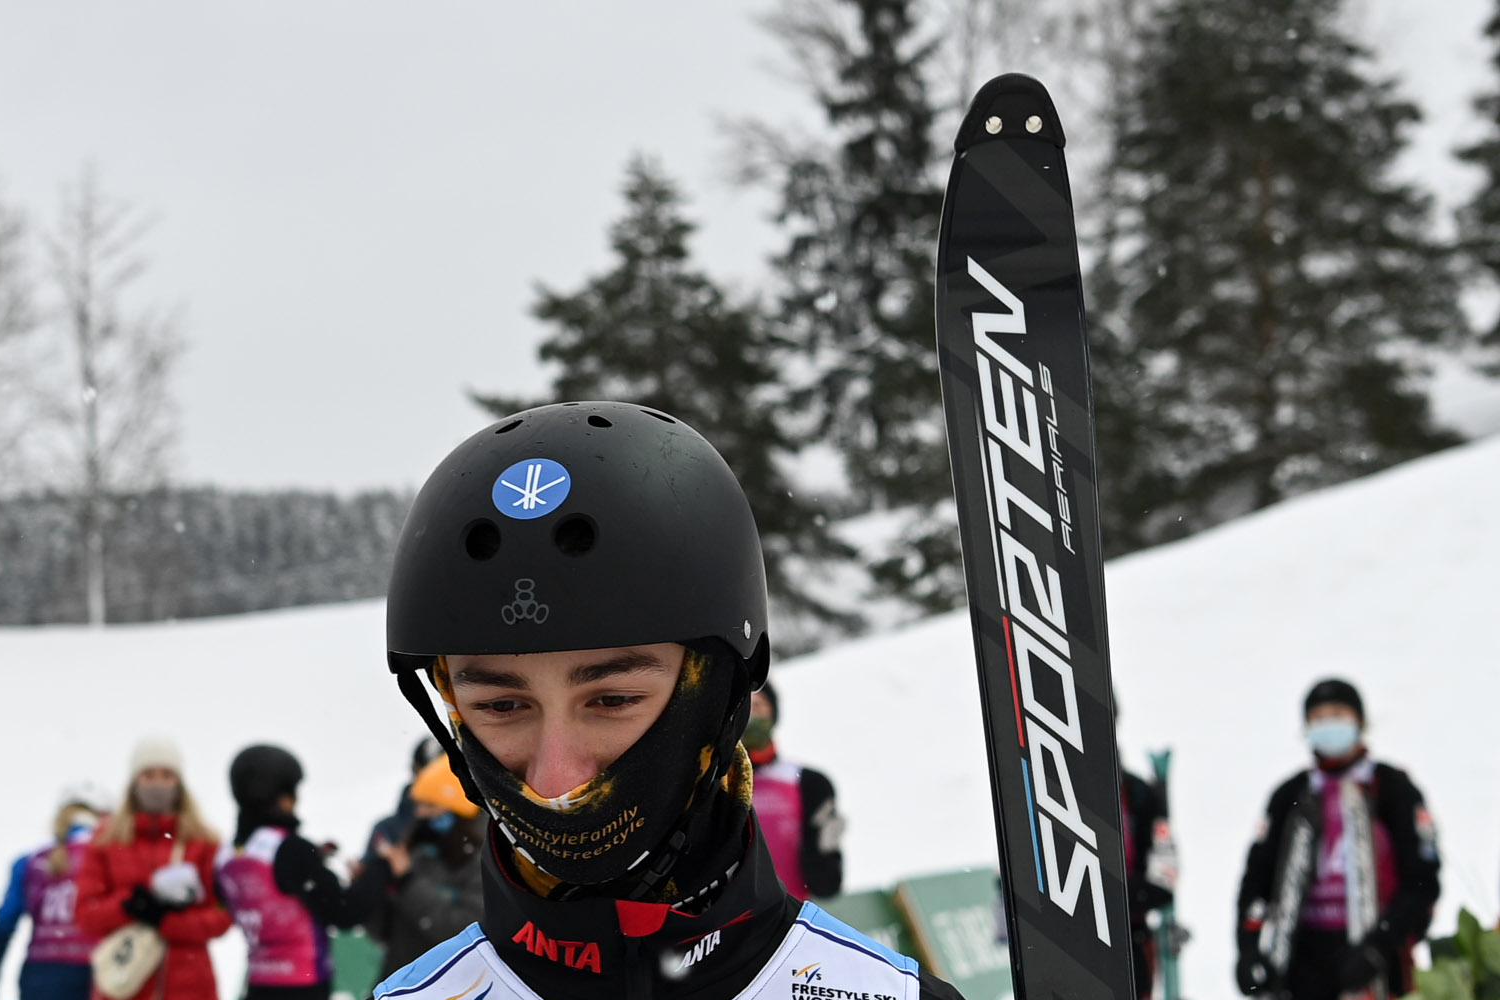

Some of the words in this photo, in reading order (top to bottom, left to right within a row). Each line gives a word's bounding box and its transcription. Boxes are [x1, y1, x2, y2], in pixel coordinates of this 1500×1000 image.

[1039, 361, 1078, 555] AERIALS
[967, 255, 1111, 947] SPORTEN
[512, 920, 601, 974] ANTA
[674, 929, 721, 973] ANTA
[791, 983, 870, 1000] FREESTYLE
[792, 969, 822, 981] FIS
